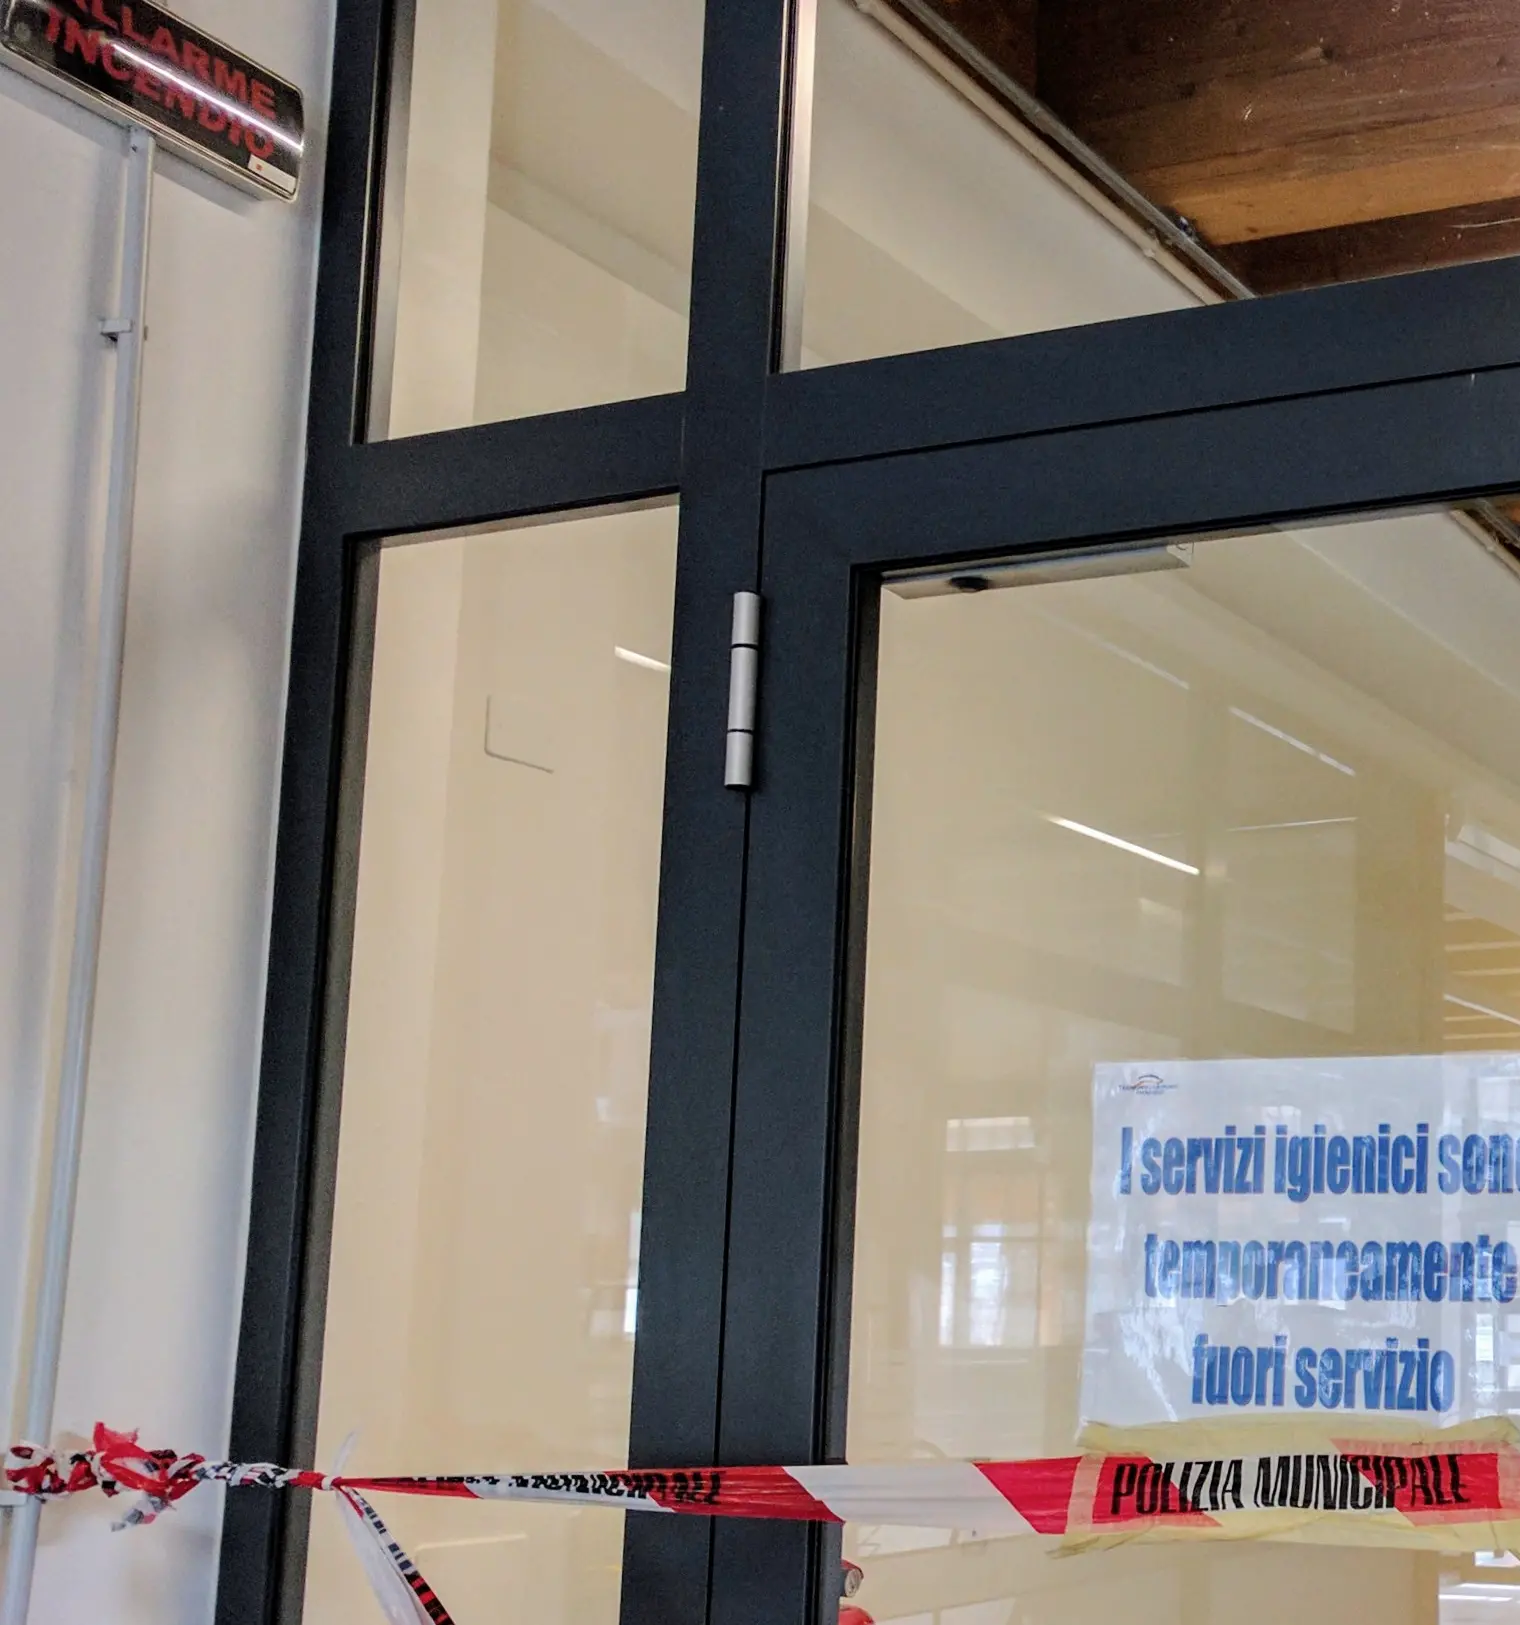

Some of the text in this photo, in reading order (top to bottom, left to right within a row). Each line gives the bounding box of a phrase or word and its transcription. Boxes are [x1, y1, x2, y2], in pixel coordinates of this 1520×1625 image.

[46, 6, 275, 159] INCENDIO
[76, 0, 276, 119] LLARME
[1141, 1125, 1266, 1195] servizi
[1274, 1123, 1429, 1203] igienici
[1144, 1233, 1518, 1304] temporaneamente
[1191, 1334, 1456, 1413] fuori servizio
[1110, 1453, 1472, 1516] POLIZIA MUNICIPALE
